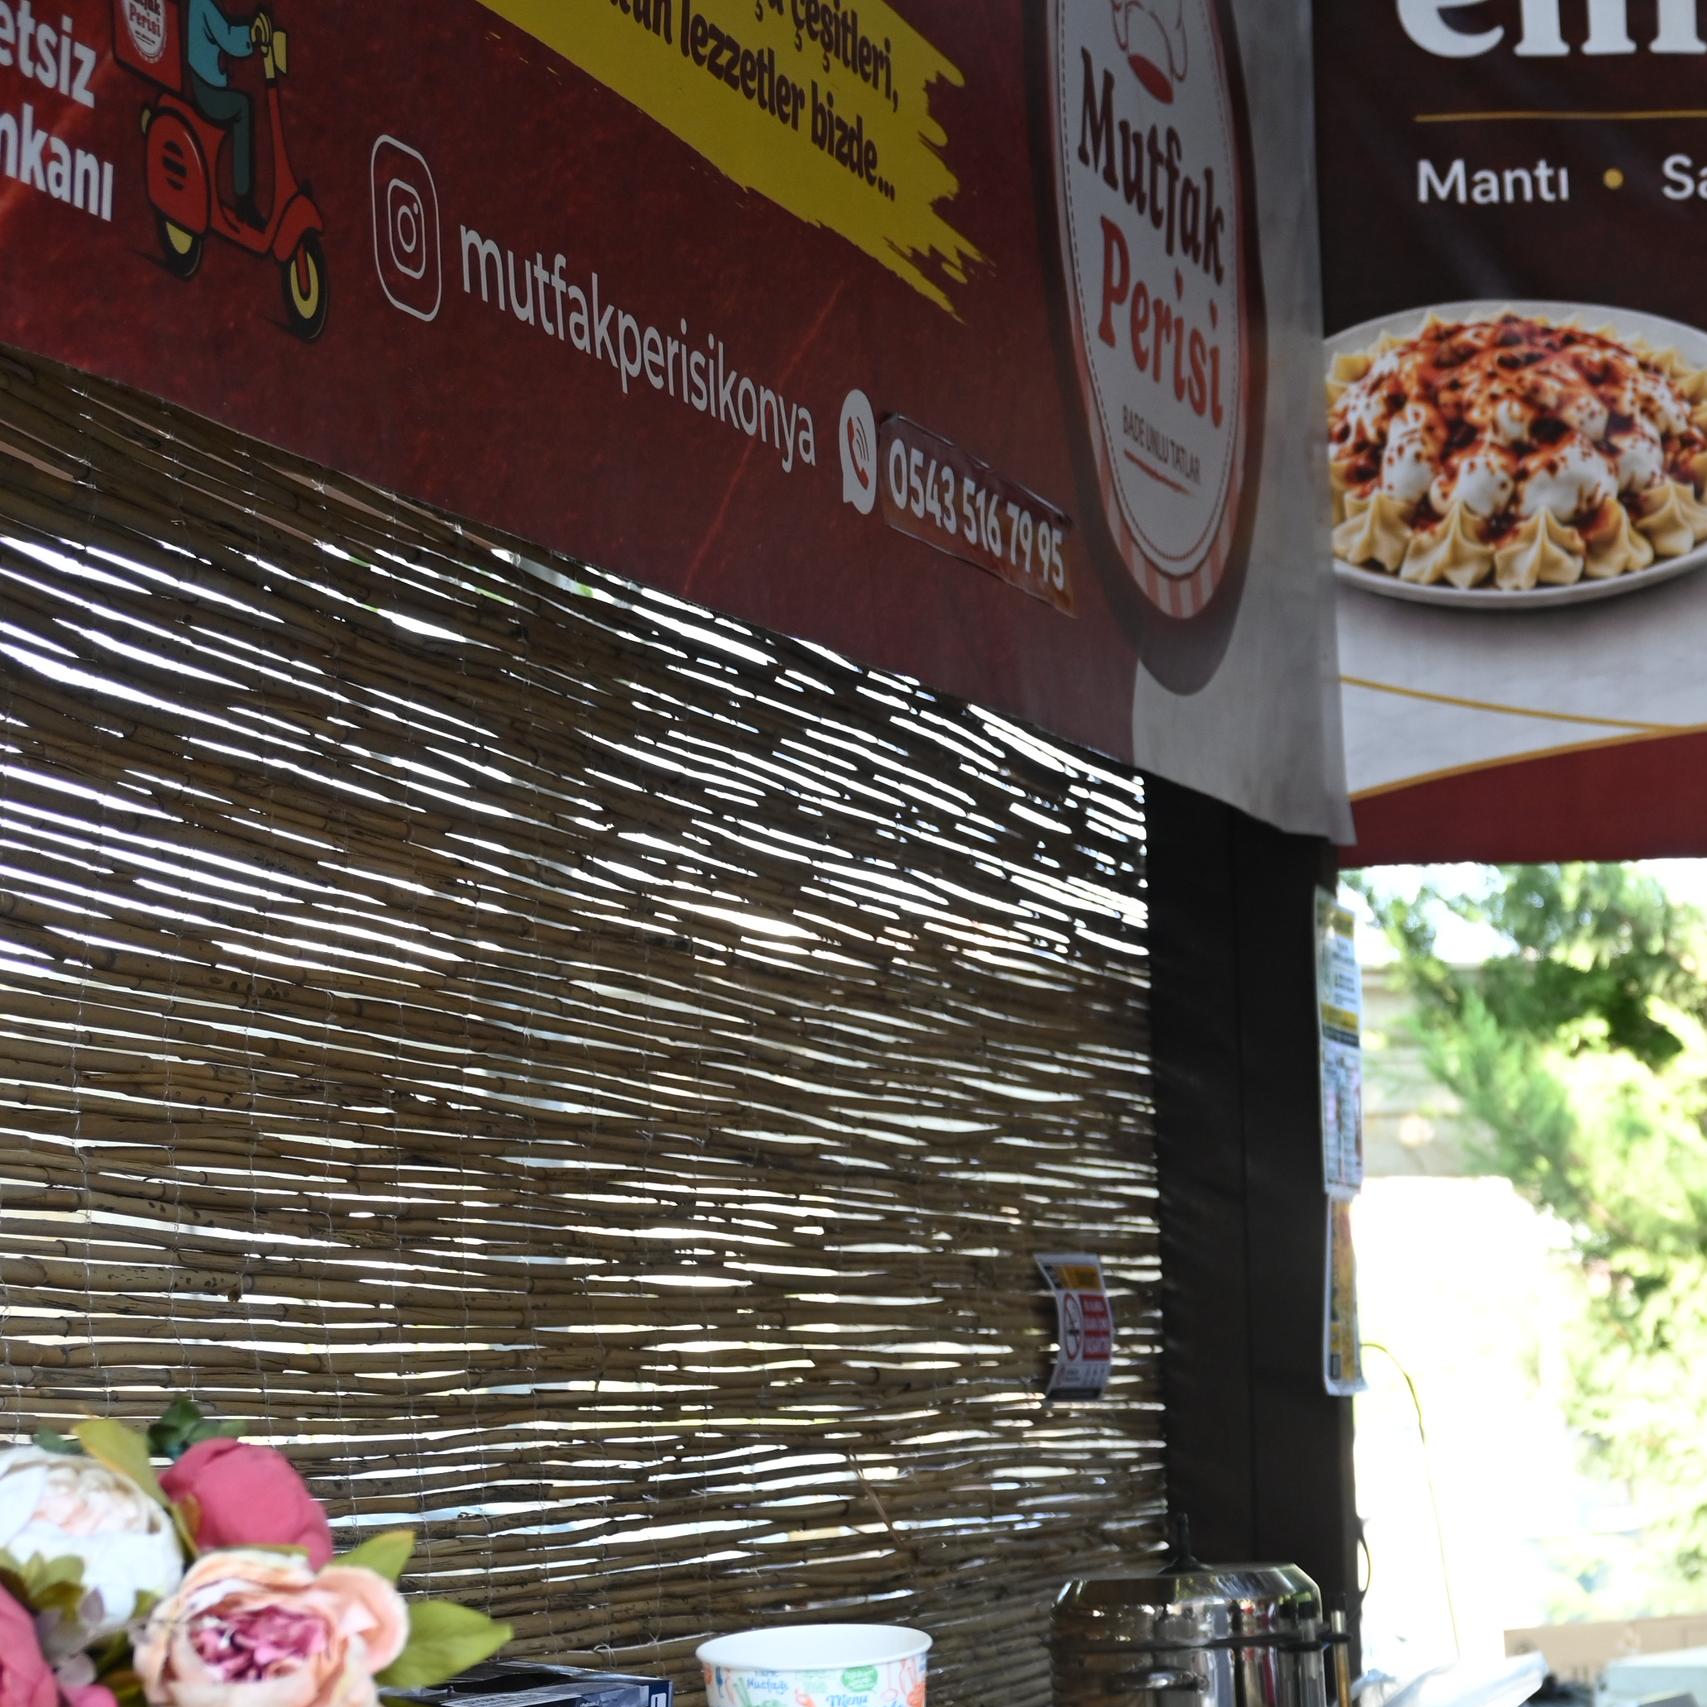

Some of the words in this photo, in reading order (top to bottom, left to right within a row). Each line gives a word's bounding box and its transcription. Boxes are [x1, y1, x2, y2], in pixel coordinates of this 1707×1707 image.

[811, 80, 895, 201] bizde...
[1077, 46, 1225, 286] Mutfak
[1416, 158, 1571, 204] Mantı
[460, 223, 816, 474] mutfakperisikonya
[1097, 215, 1225, 428] Perisi
[888, 438, 957, 535] 0543
[962, 477, 1002, 558] 516
[1006, 502, 1033, 574] 79
[1038, 521, 1065, 590] 95
